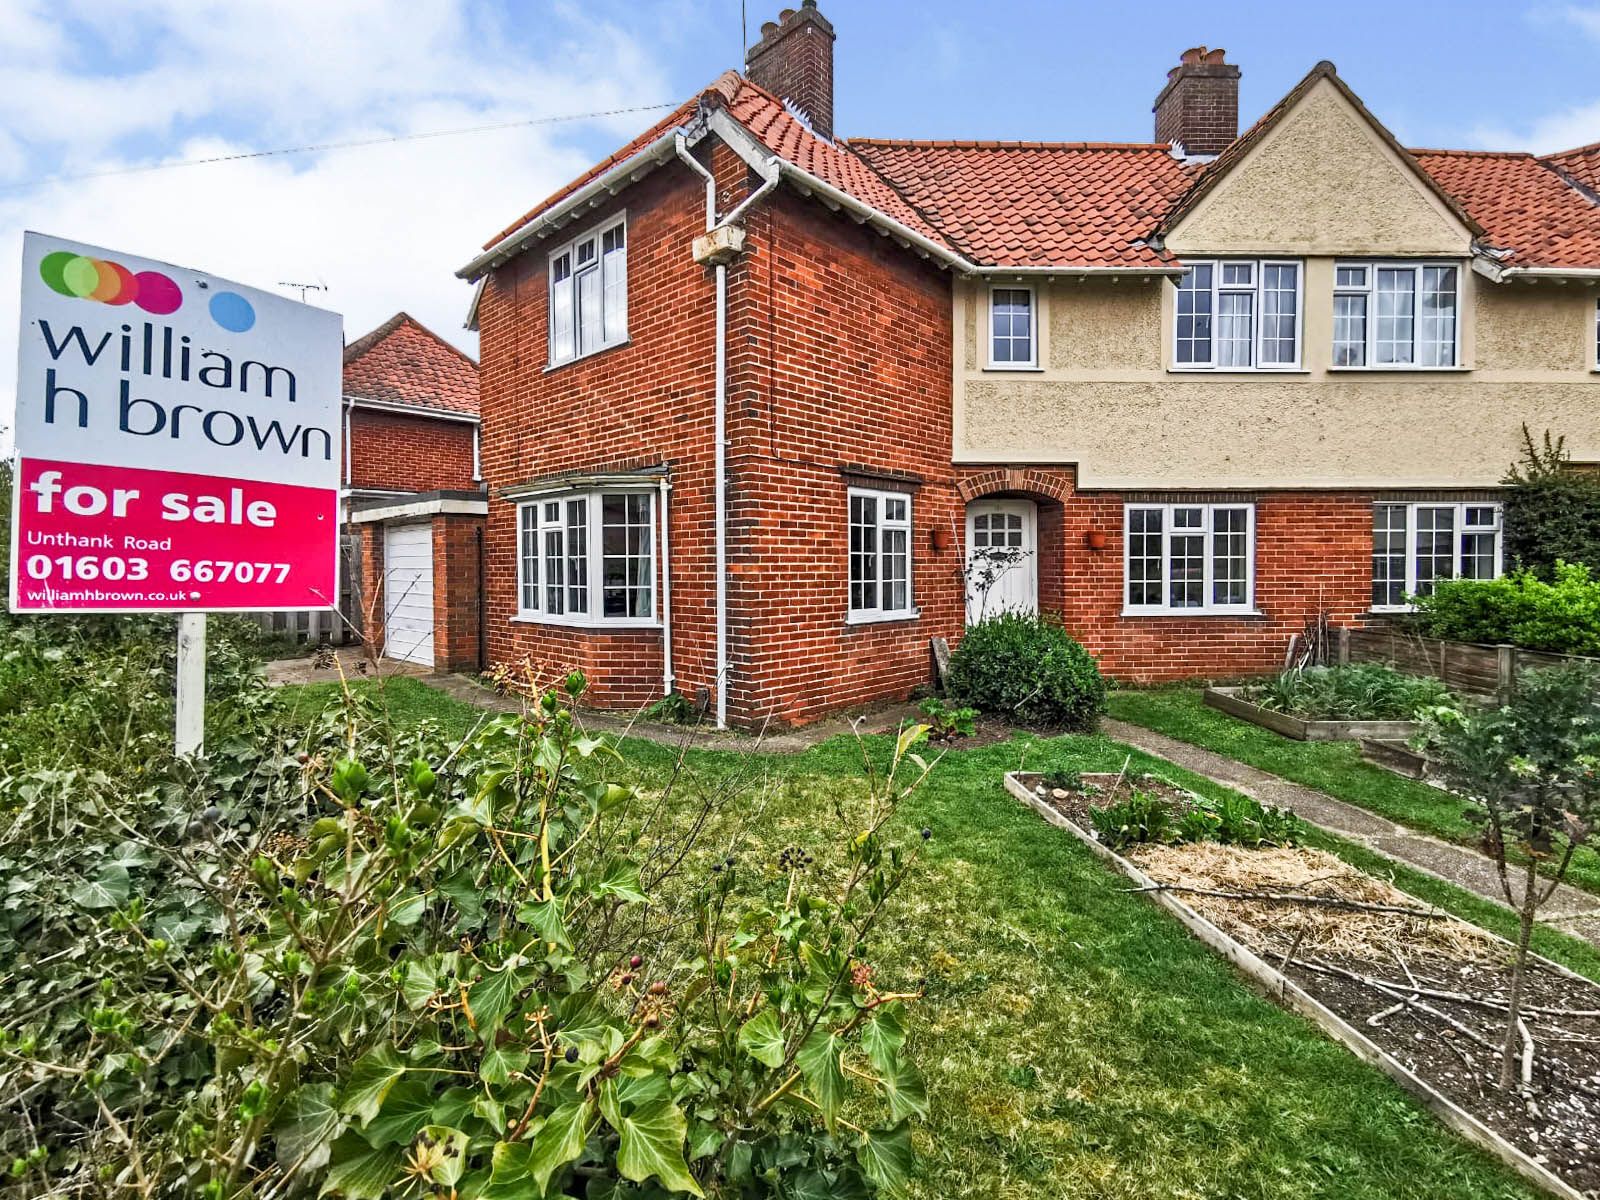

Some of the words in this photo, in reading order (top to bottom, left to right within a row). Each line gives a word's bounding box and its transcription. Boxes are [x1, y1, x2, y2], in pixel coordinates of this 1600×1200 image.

[38, 319, 296, 402] william
[45, 367, 88, 428] h
[119, 379, 331, 460] brown
[30, 471, 140, 518] for
[161, 488, 277, 527] sale
[27, 531, 113, 549] Unthank
[124, 536, 171, 551] Road
[27, 554, 148, 581] 01603
[169, 559, 291, 584] 667077
[27, 589, 187, 602] williamhbrown.co.uk
